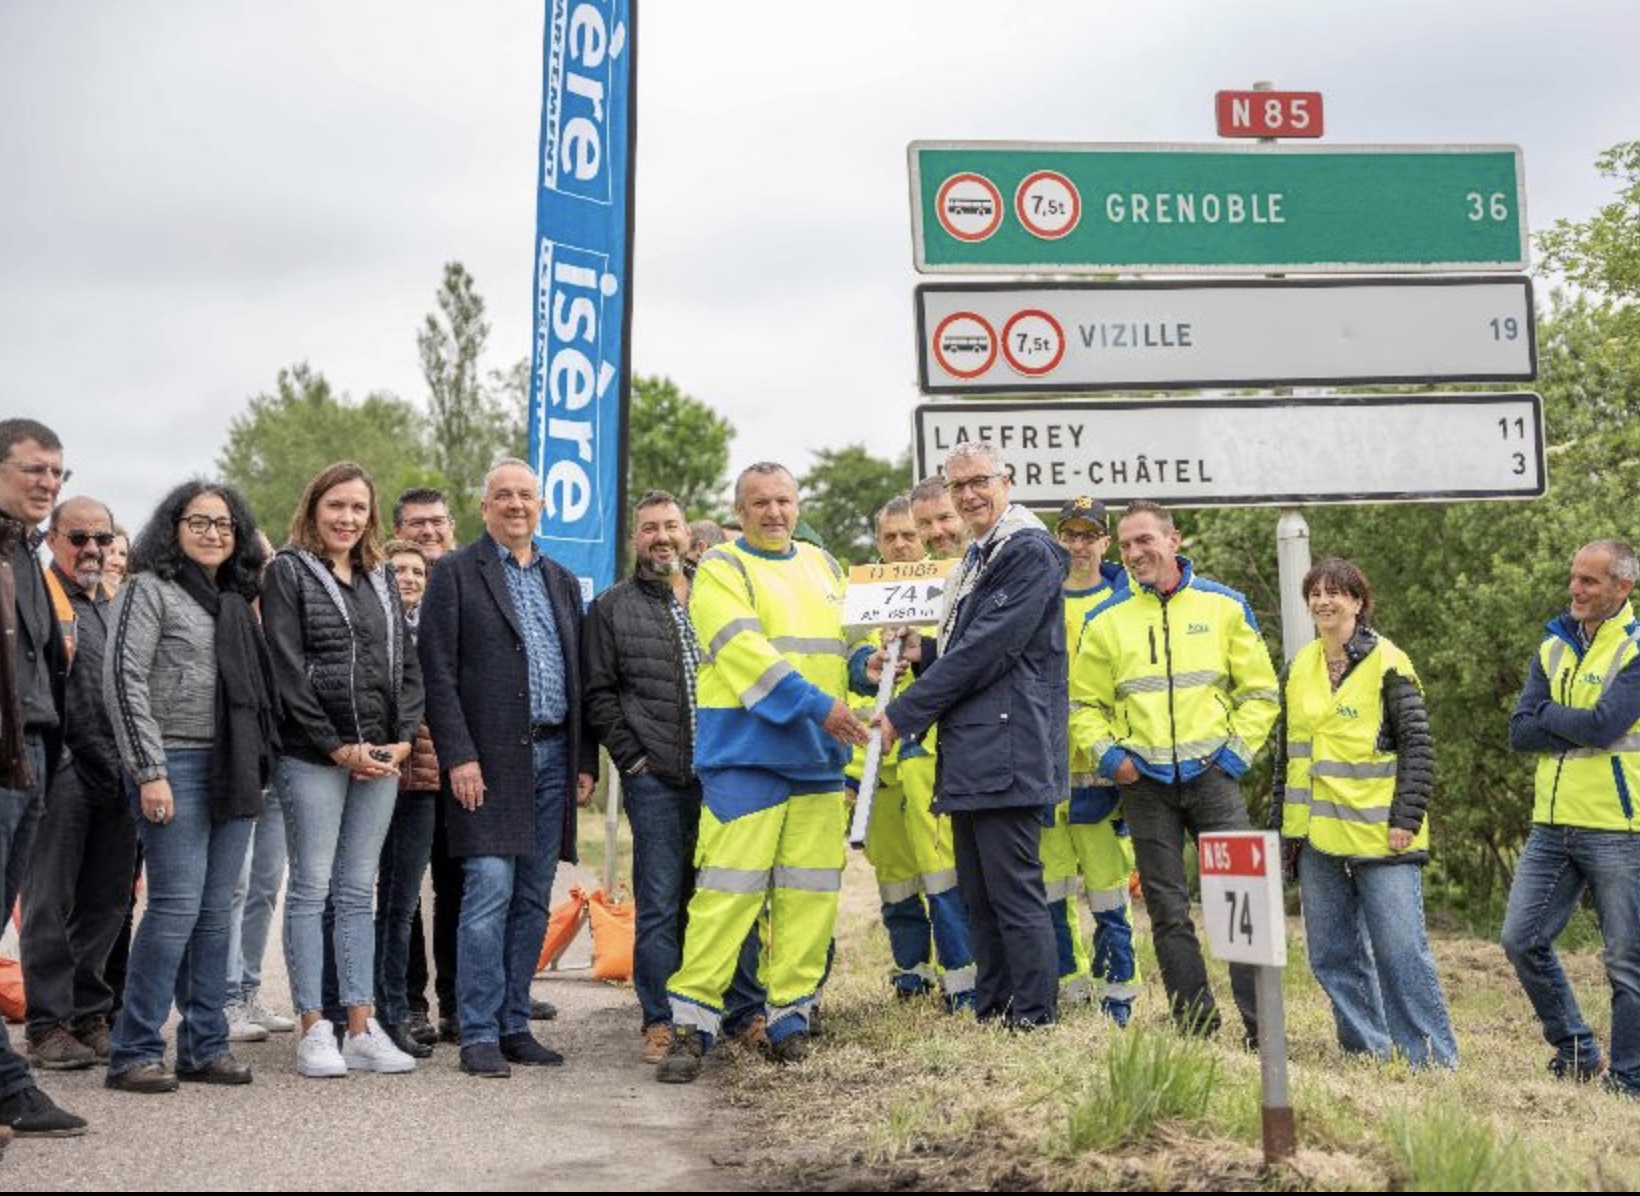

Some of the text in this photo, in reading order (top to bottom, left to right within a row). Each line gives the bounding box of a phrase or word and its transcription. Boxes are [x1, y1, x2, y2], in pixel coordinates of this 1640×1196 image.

[546, 0, 564, 177] ARTEMENT
[561, 0, 625, 180] ère
[1232, 98, 1310, 129] N 85
[1106, 193, 1285, 223] GRENOBLE
[1466, 192, 1508, 221] 36
[1078, 322, 1193, 348] VIZILLE
[1490, 317, 1518, 341] 19
[545, 262, 617, 522] isère
[934, 417, 1524, 449] LAFFREY 11
[936, 452, 1526, 486] RRE-CHÂTEL 3
[884, 585, 918, 605] 74
[1224, 891, 1253, 946] 74
